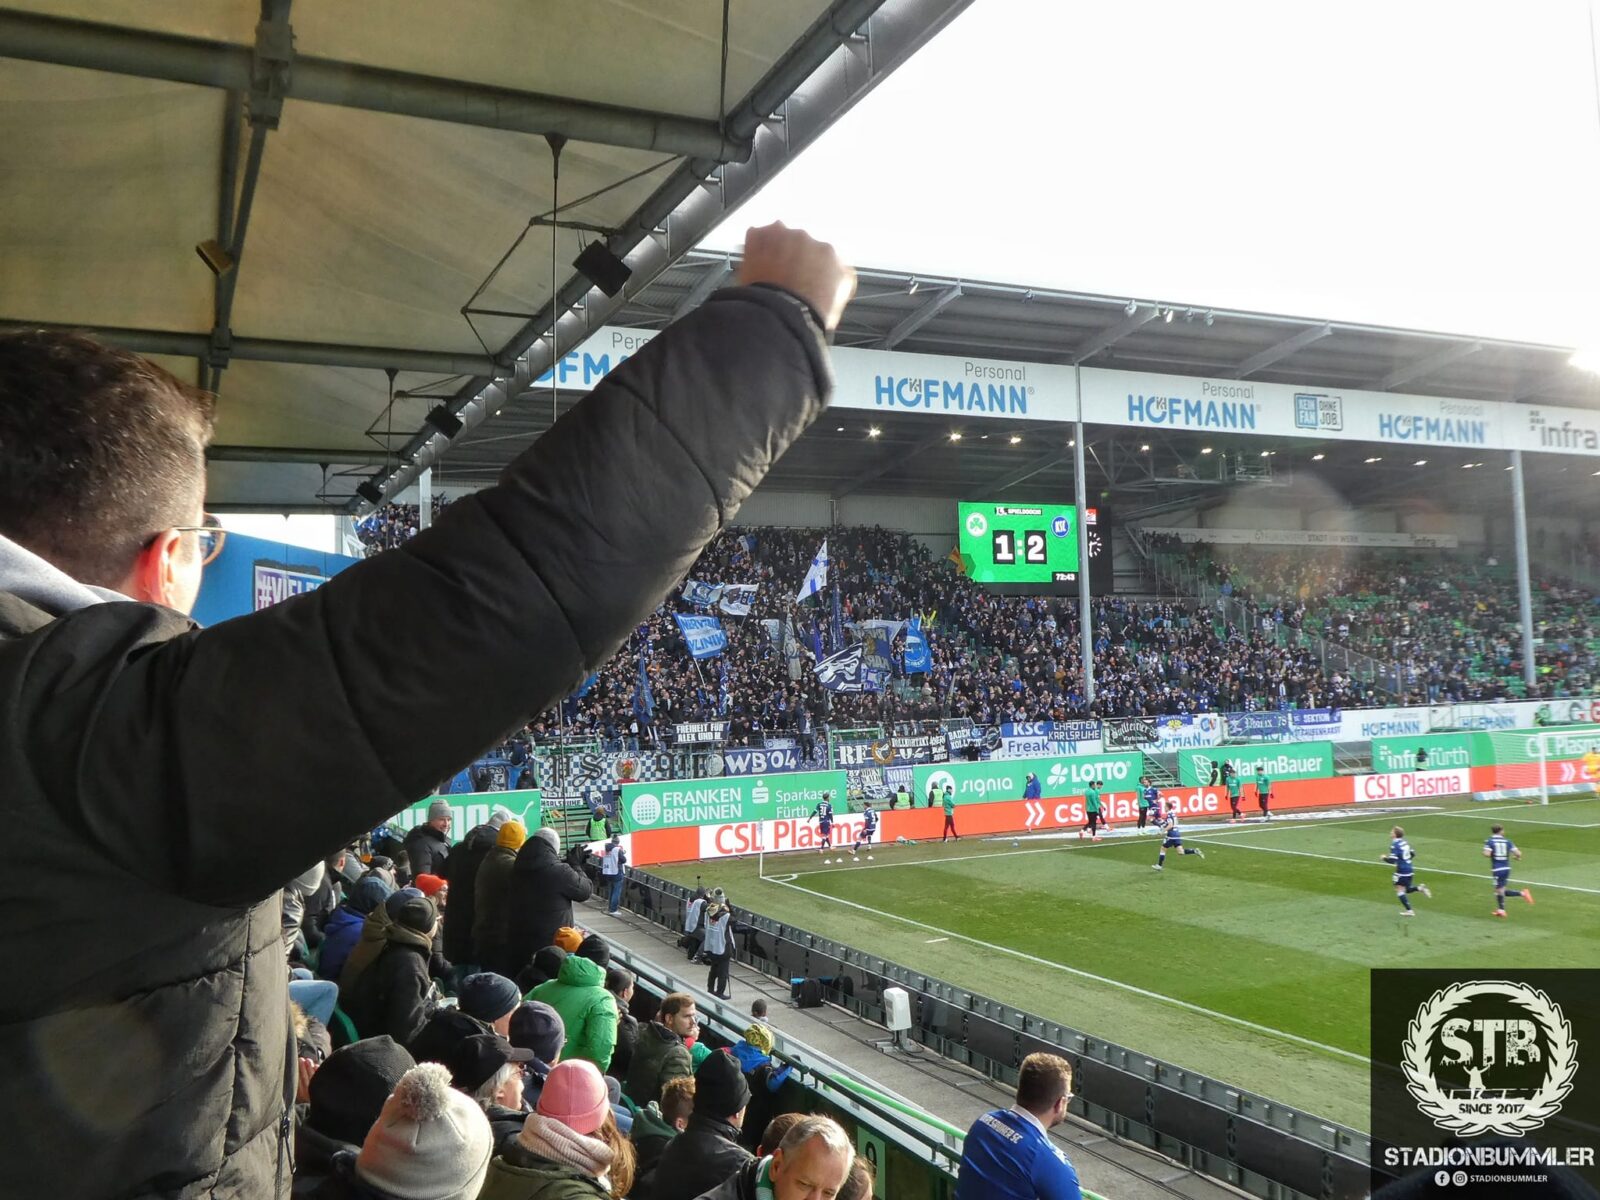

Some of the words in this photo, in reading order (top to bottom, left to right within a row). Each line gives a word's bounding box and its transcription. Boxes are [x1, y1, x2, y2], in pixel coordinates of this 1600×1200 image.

[965, 361, 1027, 382] Personal
[875, 375, 1028, 414] HOFMANN
[1202, 382, 1255, 399] Personal
[1128, 394, 1256, 430] HOFMANN
[1440, 400, 1483, 416] Personal
[1378, 412, 1485, 443] HOFMANN
[1541, 421, 1598, 450] infra
[676, 724, 708, 733] FREIHEIT
[677, 734, 696, 742] ALEX
[1012, 721, 1044, 736] KSC
[1048, 730, 1100, 741] KARLSRUHE
[1361, 720, 1421, 737] HOFMANN
[1008, 738, 1050, 753] Freak
[1072, 761, 1128, 783] LOTTO
[1228, 755, 1323, 777] MartinBauer
[960, 778, 1013, 797] signia
[1364, 774, 1396, 800] CSL
[1401, 771, 1461, 796] Plasma
[662, 787, 742, 806] FRANKEN
[662, 803, 742, 824] BRUNNEN
[776, 806, 808, 819] Fürth
[715, 823, 765, 855] CSL
